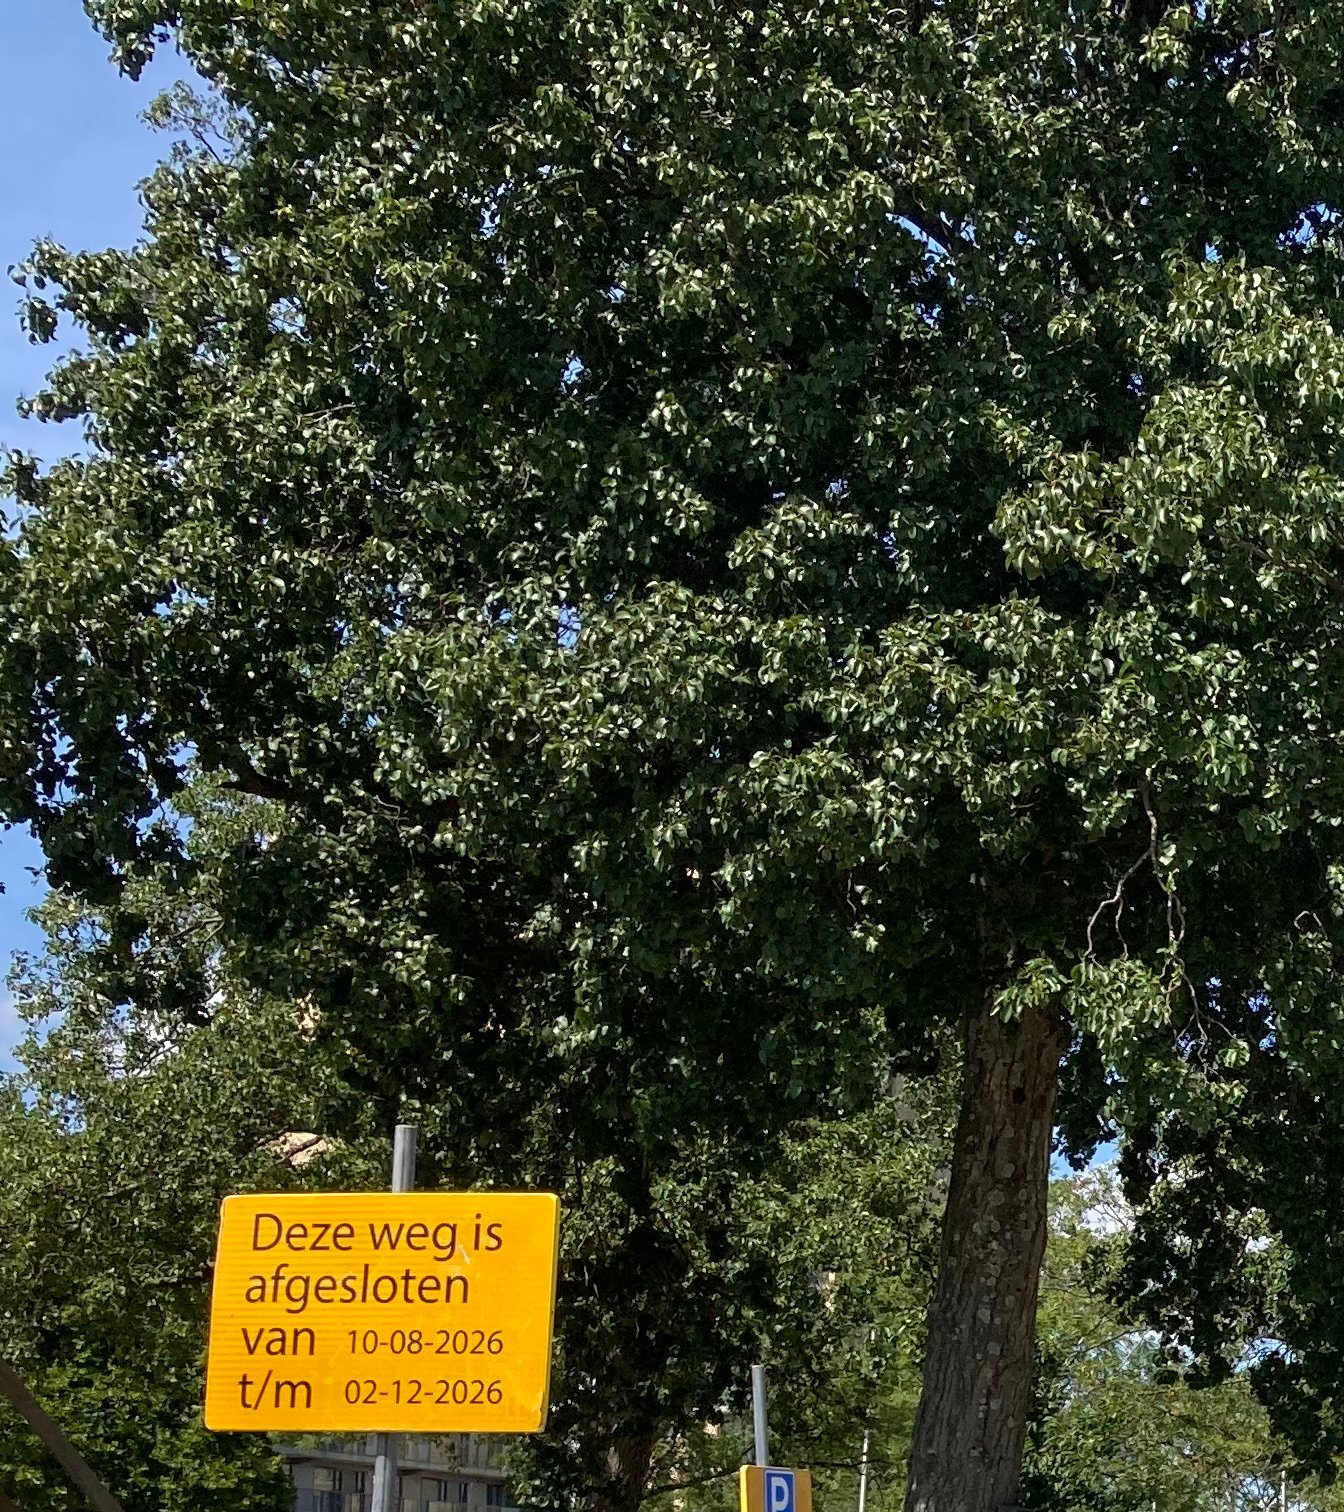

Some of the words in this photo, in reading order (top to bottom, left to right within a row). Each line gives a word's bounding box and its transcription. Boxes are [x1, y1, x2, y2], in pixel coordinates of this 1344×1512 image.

[251, 1212, 355, 1251] Deze
[369, 1222, 458, 1262] weg
[473, 1213, 504, 1251] is
[244, 1263, 470, 1314] afgesloten
[241, 1327, 316, 1357] van
[346, 1329, 504, 1356] 10-08-2026
[237, 1370, 313, 1411] t/m
[344, 1379, 504, 1405] 02-12-2026
